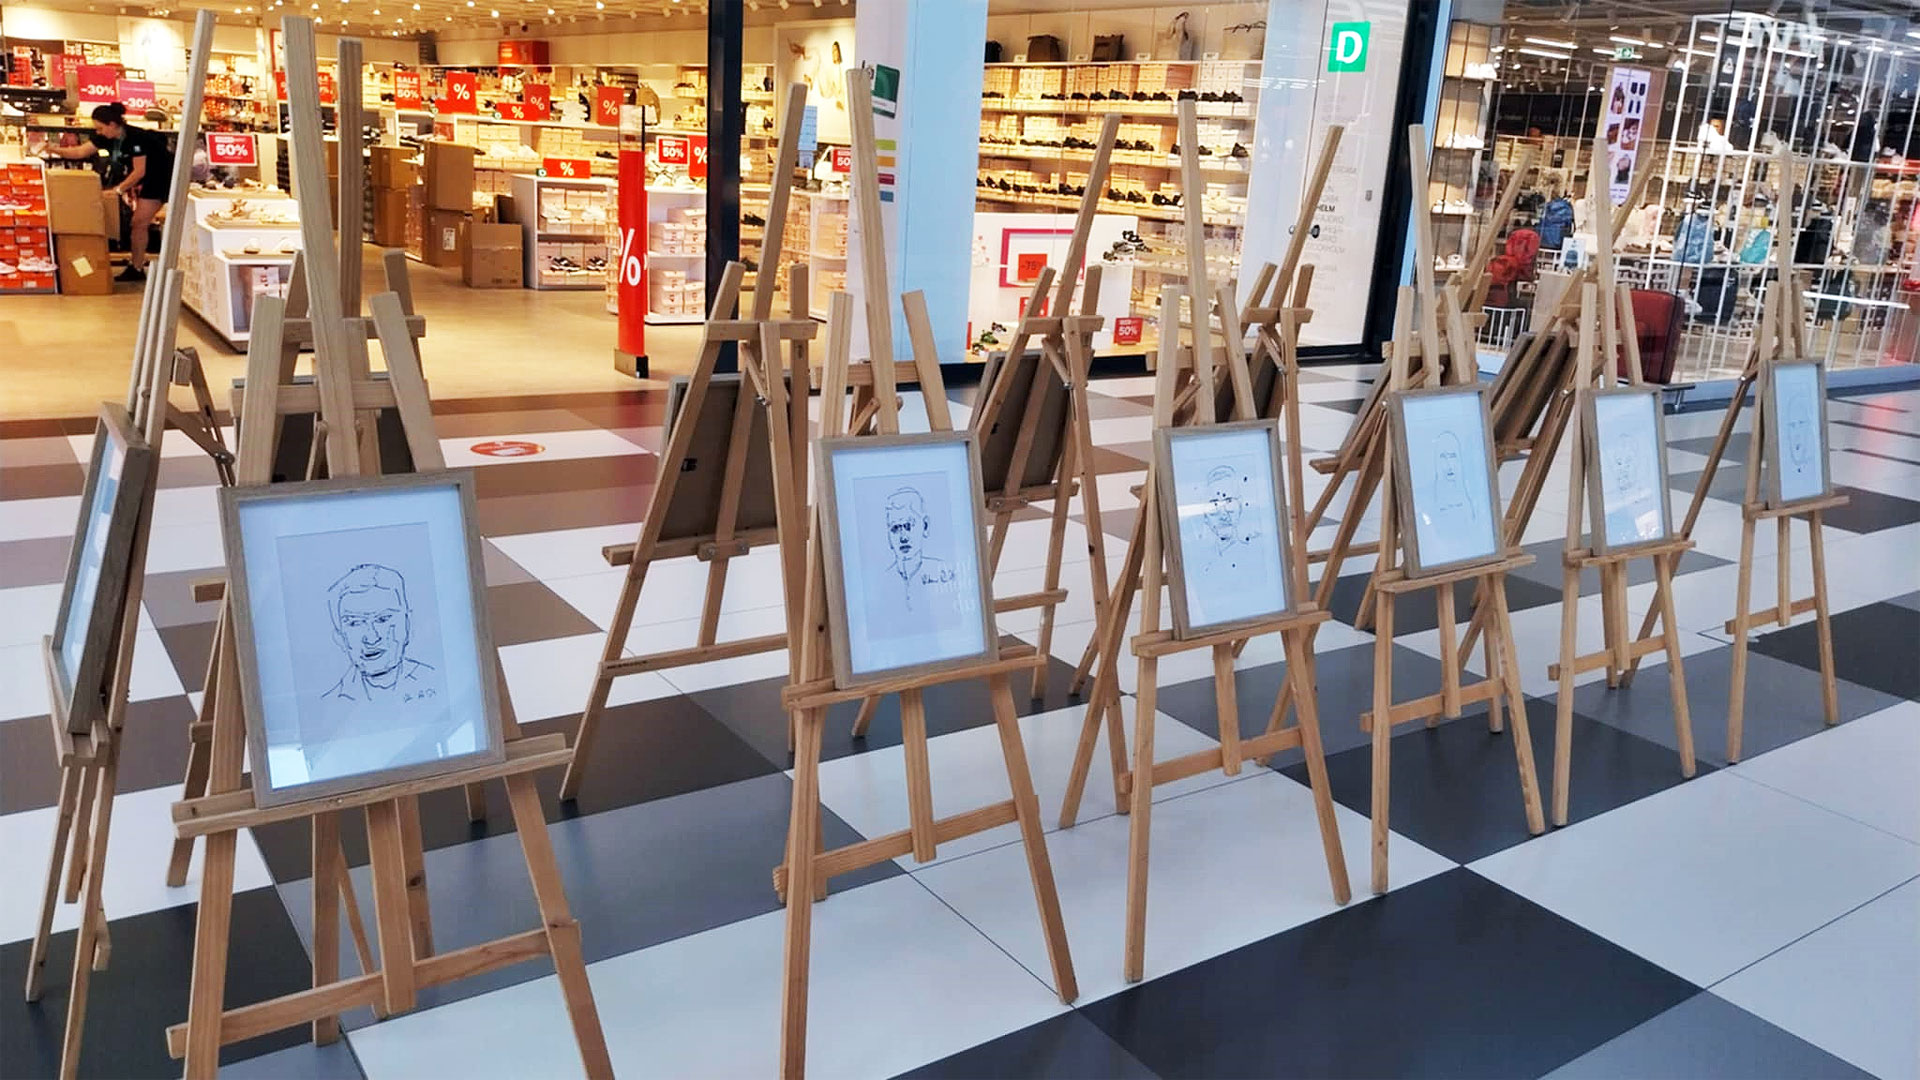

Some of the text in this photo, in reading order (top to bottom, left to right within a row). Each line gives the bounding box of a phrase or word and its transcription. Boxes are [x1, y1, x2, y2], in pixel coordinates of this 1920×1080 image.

[1336, 31, 1363, 63] D
[396, 76, 418, 84] SALE
[80, 84, 115, 96] -30%
[397, 89, 419, 98] 50%
[453, 83, 470, 100] %
[530, 97, 545, 111] %
[603, 99, 618, 115] %
[511, 105, 525, 119] %
[215, 144, 249, 156] 50%
[662, 146, 685, 158] 50%
[694, 146, 708, 164] %
[560, 161, 575, 176] %
[618, 227, 641, 286] %
[1118, 325, 1138, 336] 50%
